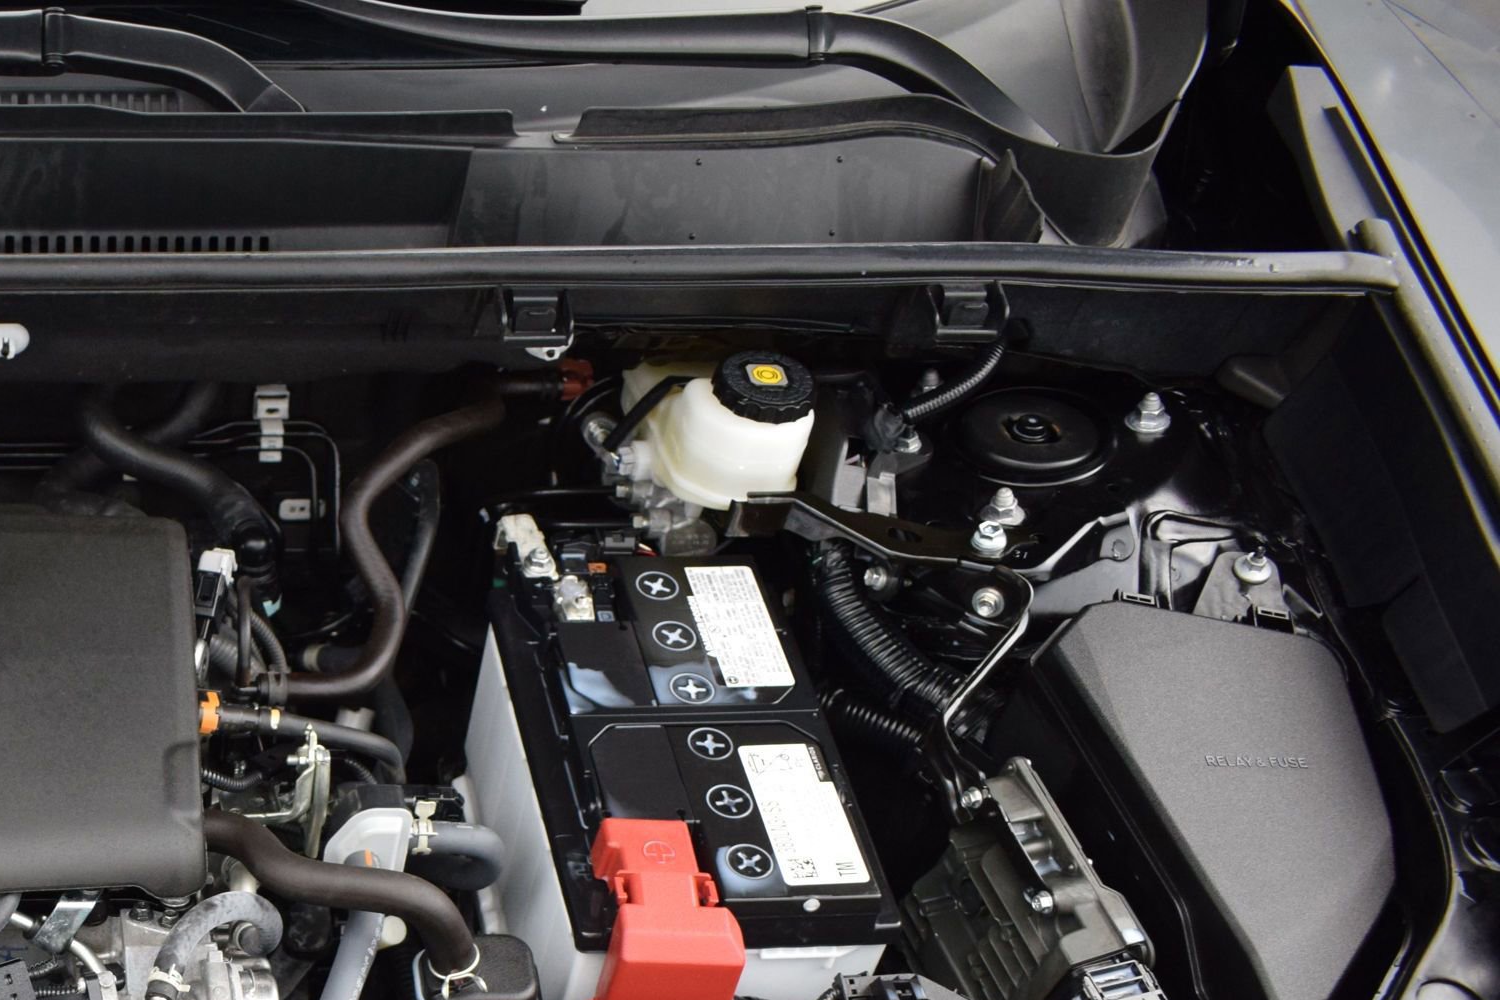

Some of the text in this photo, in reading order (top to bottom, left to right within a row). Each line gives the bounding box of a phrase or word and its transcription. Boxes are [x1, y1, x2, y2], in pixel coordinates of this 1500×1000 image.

[1205, 755, 1309, 769] RELAY & FUSE
